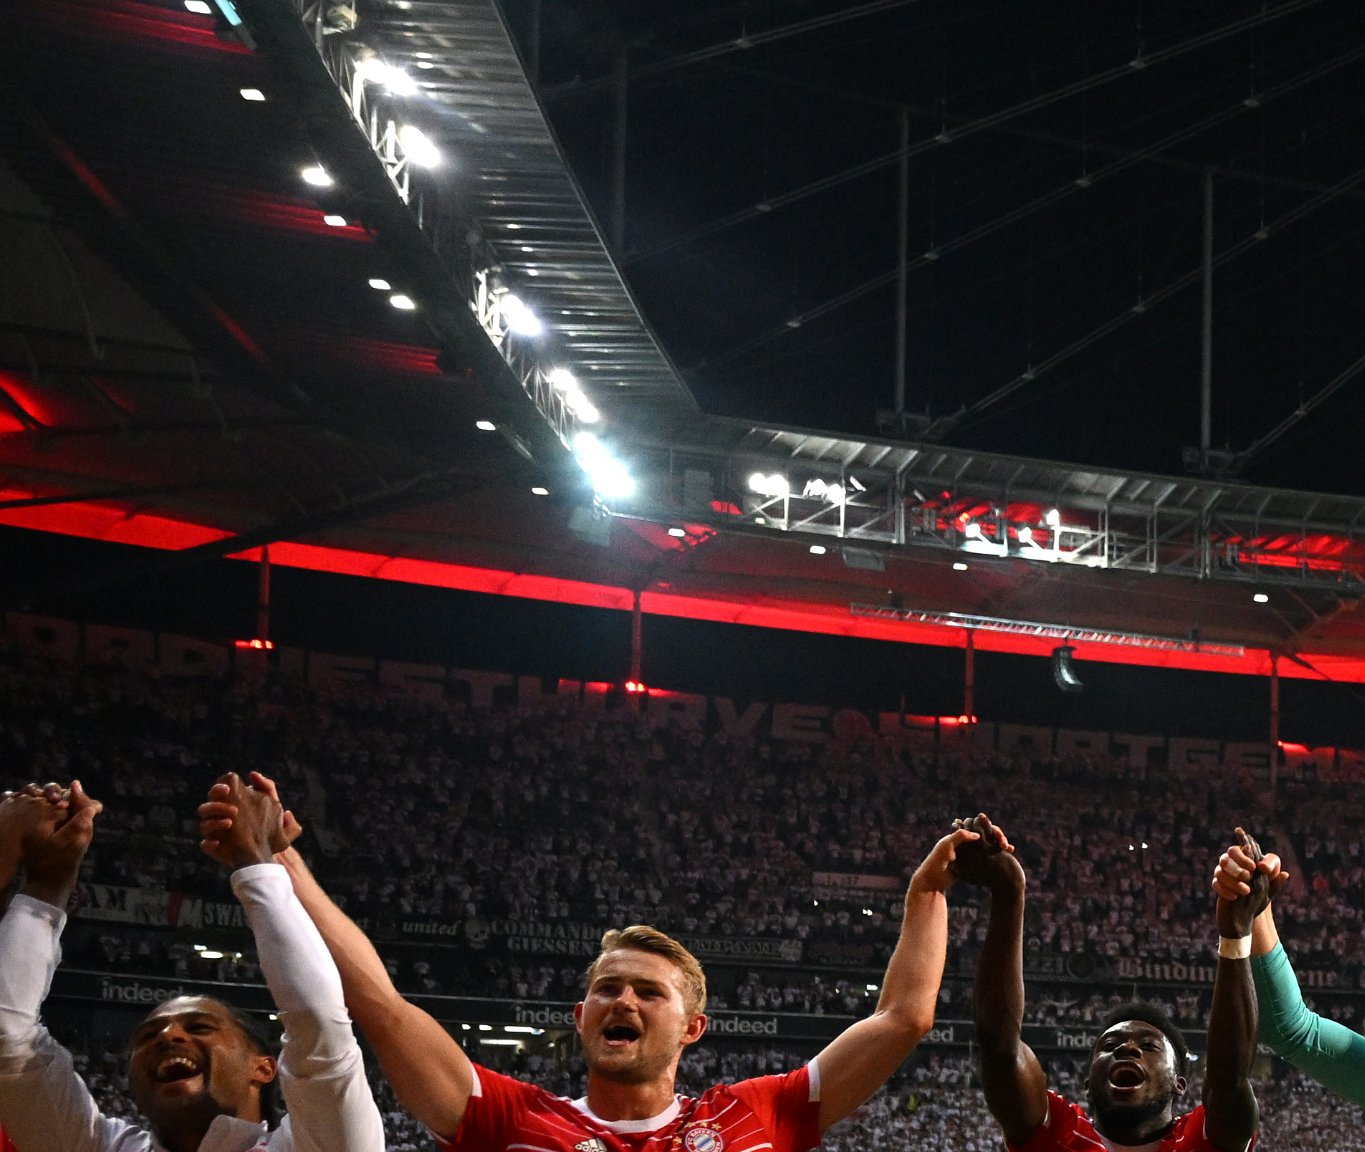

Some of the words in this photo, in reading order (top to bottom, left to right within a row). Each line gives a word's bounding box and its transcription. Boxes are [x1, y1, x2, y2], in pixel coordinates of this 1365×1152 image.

[403, 920, 462, 936] united
[508, 936, 595, 955] GIESSEN
[1118, 958, 1216, 982] Bindin
[514, 1005, 575, 1024] indee
[707, 1016, 777, 1035] indeed
